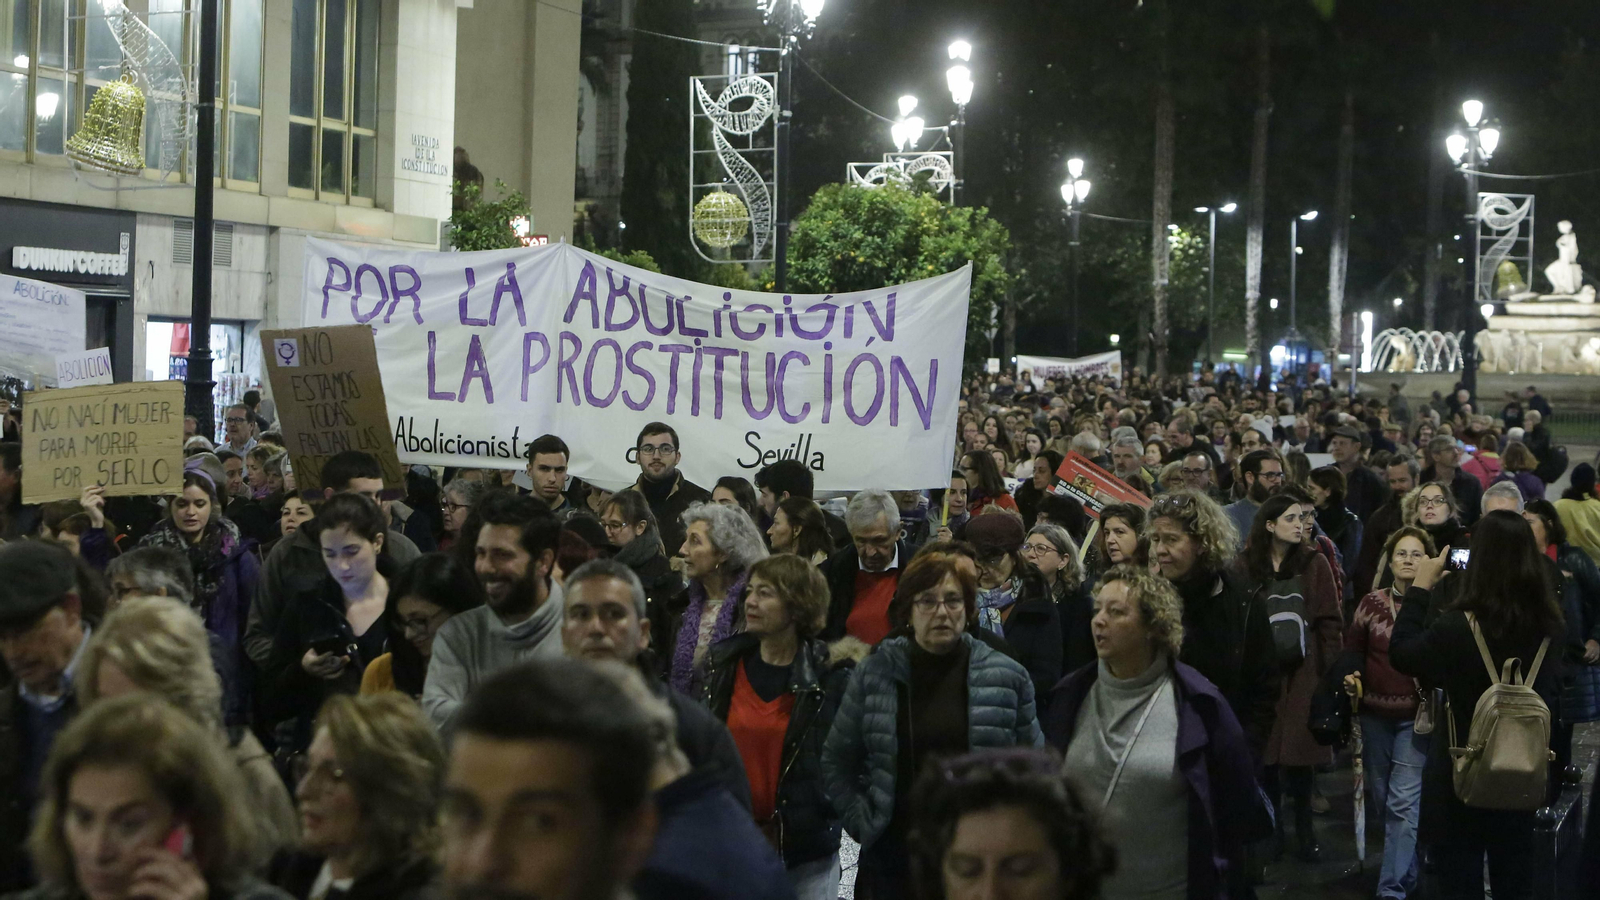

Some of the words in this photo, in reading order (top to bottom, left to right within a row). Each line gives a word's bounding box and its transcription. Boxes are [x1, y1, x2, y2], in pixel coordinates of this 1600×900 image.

[411, 133, 439, 149] AVENIDA
[415, 147, 424, 160] DE
[425, 149, 435, 161] LA
[401, 157, 448, 176] CONSTITUCION
[321, 256, 424, 325] POR
[458, 261, 527, 327] LA
[302, 331, 334, 366] NO
[59, 353, 111, 382] ABOLICIÓN
[427, 331, 494, 404] LA
[291, 370, 361, 402] ESTAMOS
[32, 402, 60, 433] NO
[67, 397, 107, 428] NACÍ
[112, 401, 171, 425] MUJER
[306, 400, 357, 429] TODAS
[39, 437, 77, 461] PARA
[84, 431, 139, 456] MORIR
[298, 432, 352, 455] FALTAN
[355, 426, 381, 450] LAS
[737, 430, 825, 472] Sevilla
[53, 466, 83, 489] POR
